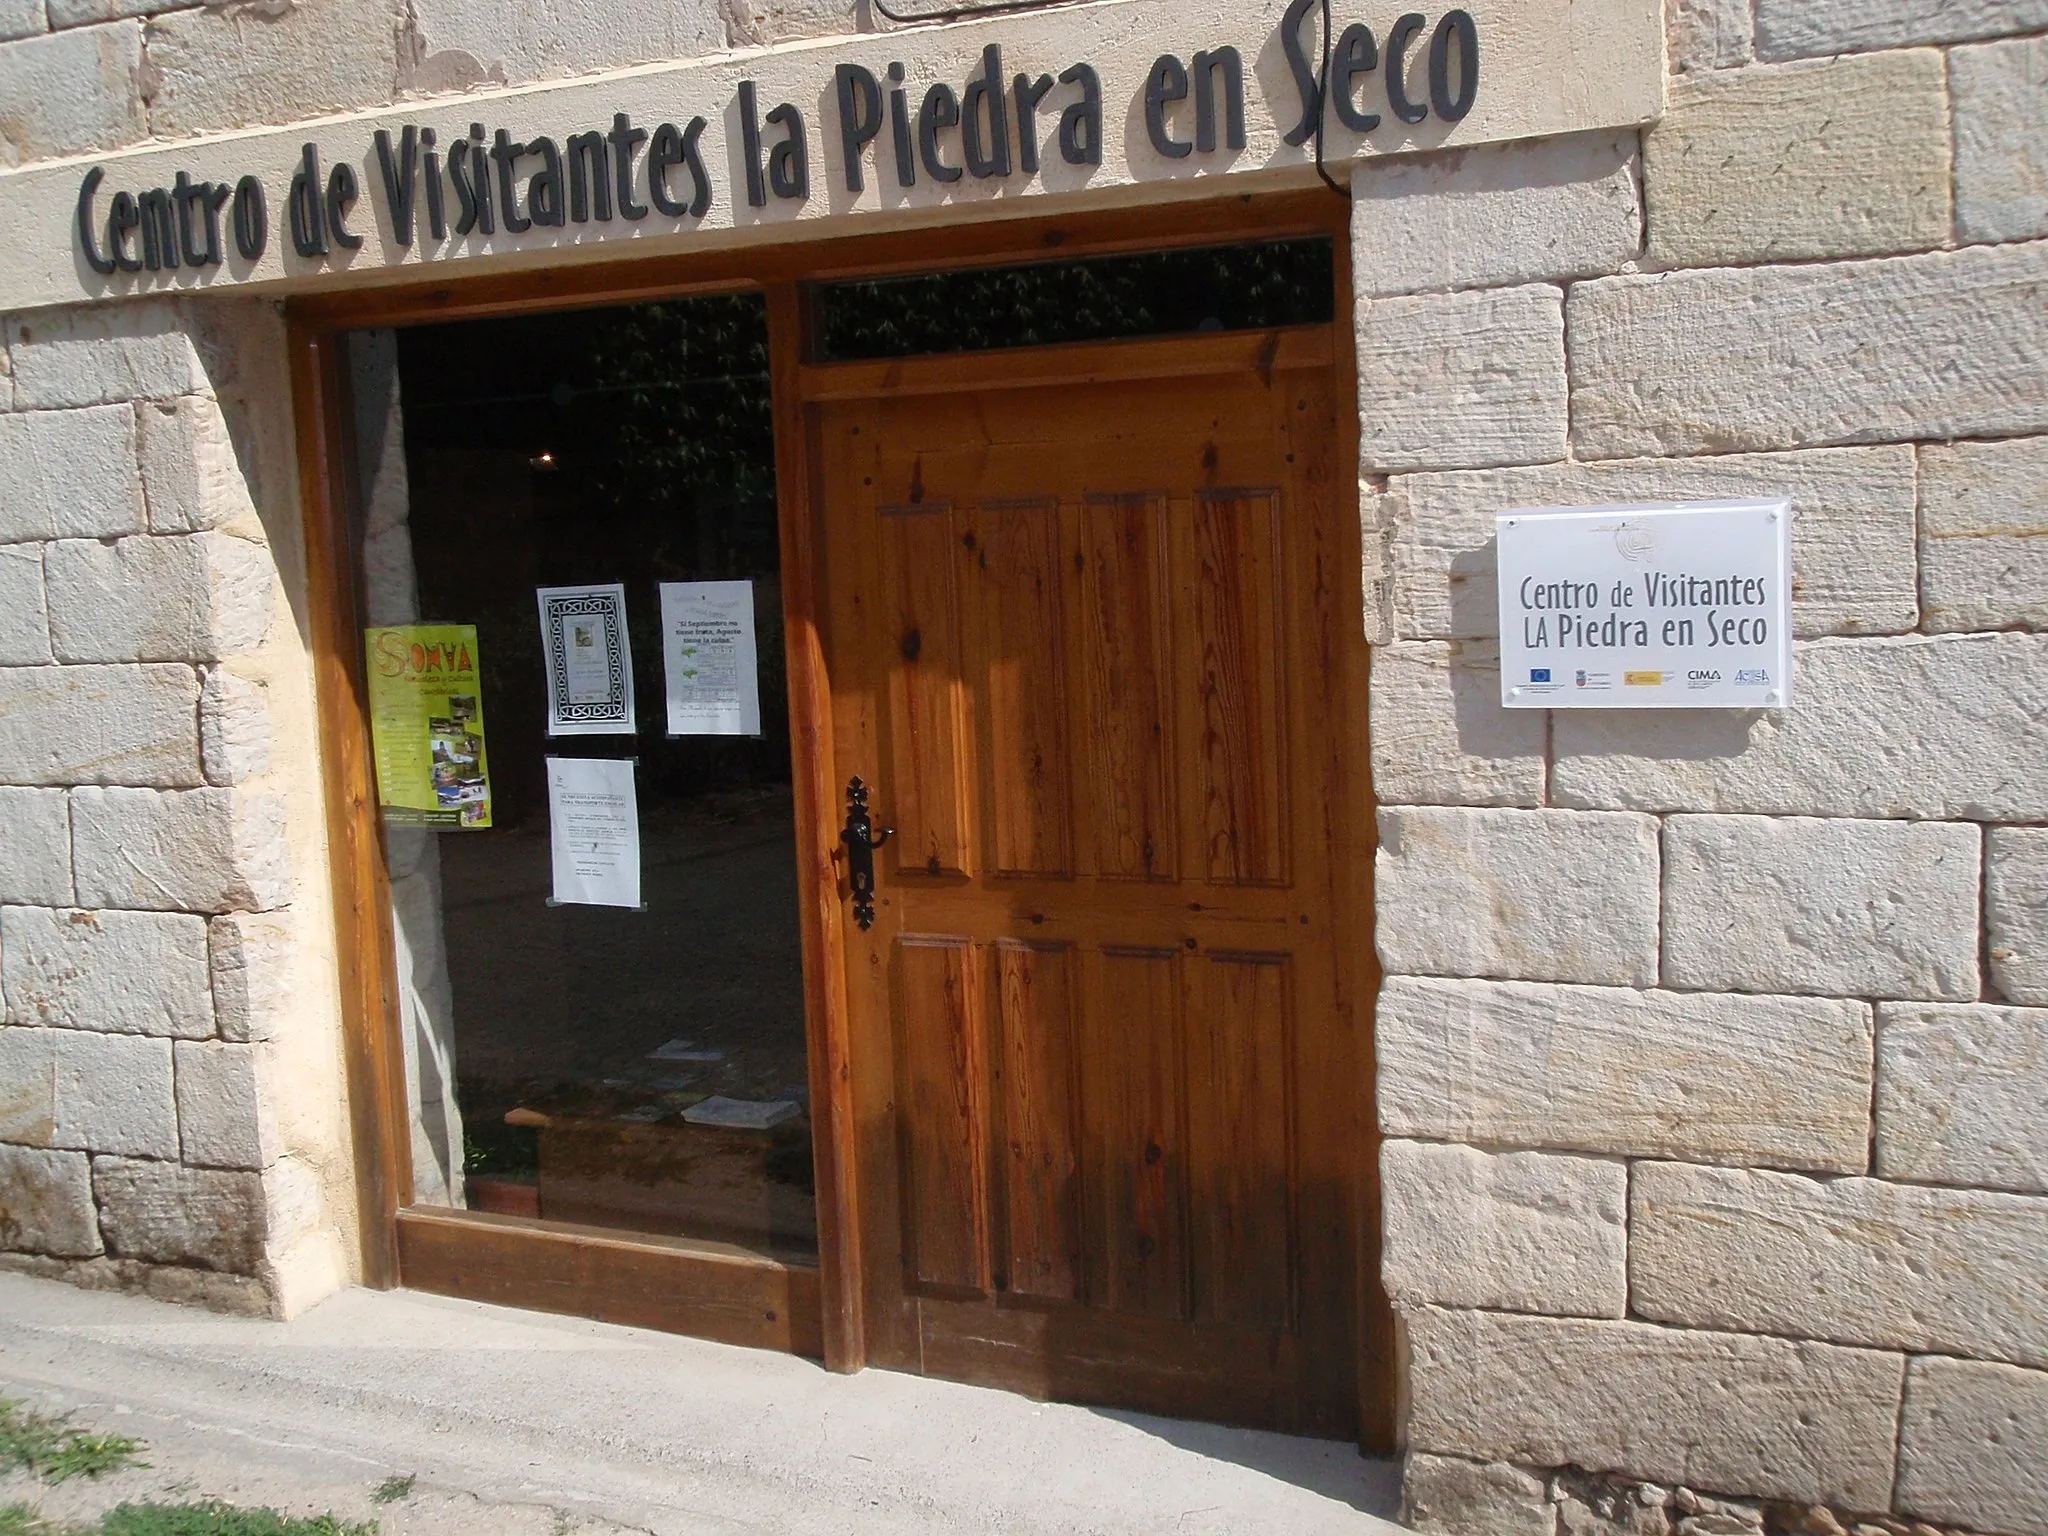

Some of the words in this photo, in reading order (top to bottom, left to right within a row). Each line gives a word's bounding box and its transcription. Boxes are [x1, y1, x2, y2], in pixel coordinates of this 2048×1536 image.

[78, 165, 268, 275] Centro
[290, 142, 363, 258] de
[373, 111, 713, 247] Visitantes
[737, 80, 809, 207] la
[835, 42, 1102, 192] Piedra
[1145, 44, 1247, 159] en
[1282, 0, 1480, 148] Seco
[1519, 575, 1599, 610] Centro
[1610, 580, 1634, 608] de
[1643, 571, 1767, 608] Visitantes
[1524, 615, 1549, 649] LA
[1558, 612, 1649, 648] Piedra
[1661, 617, 1694, 647] en
[1706, 609, 1768, 648] Seco
[1687, 669, 1722, 680] CIMA
